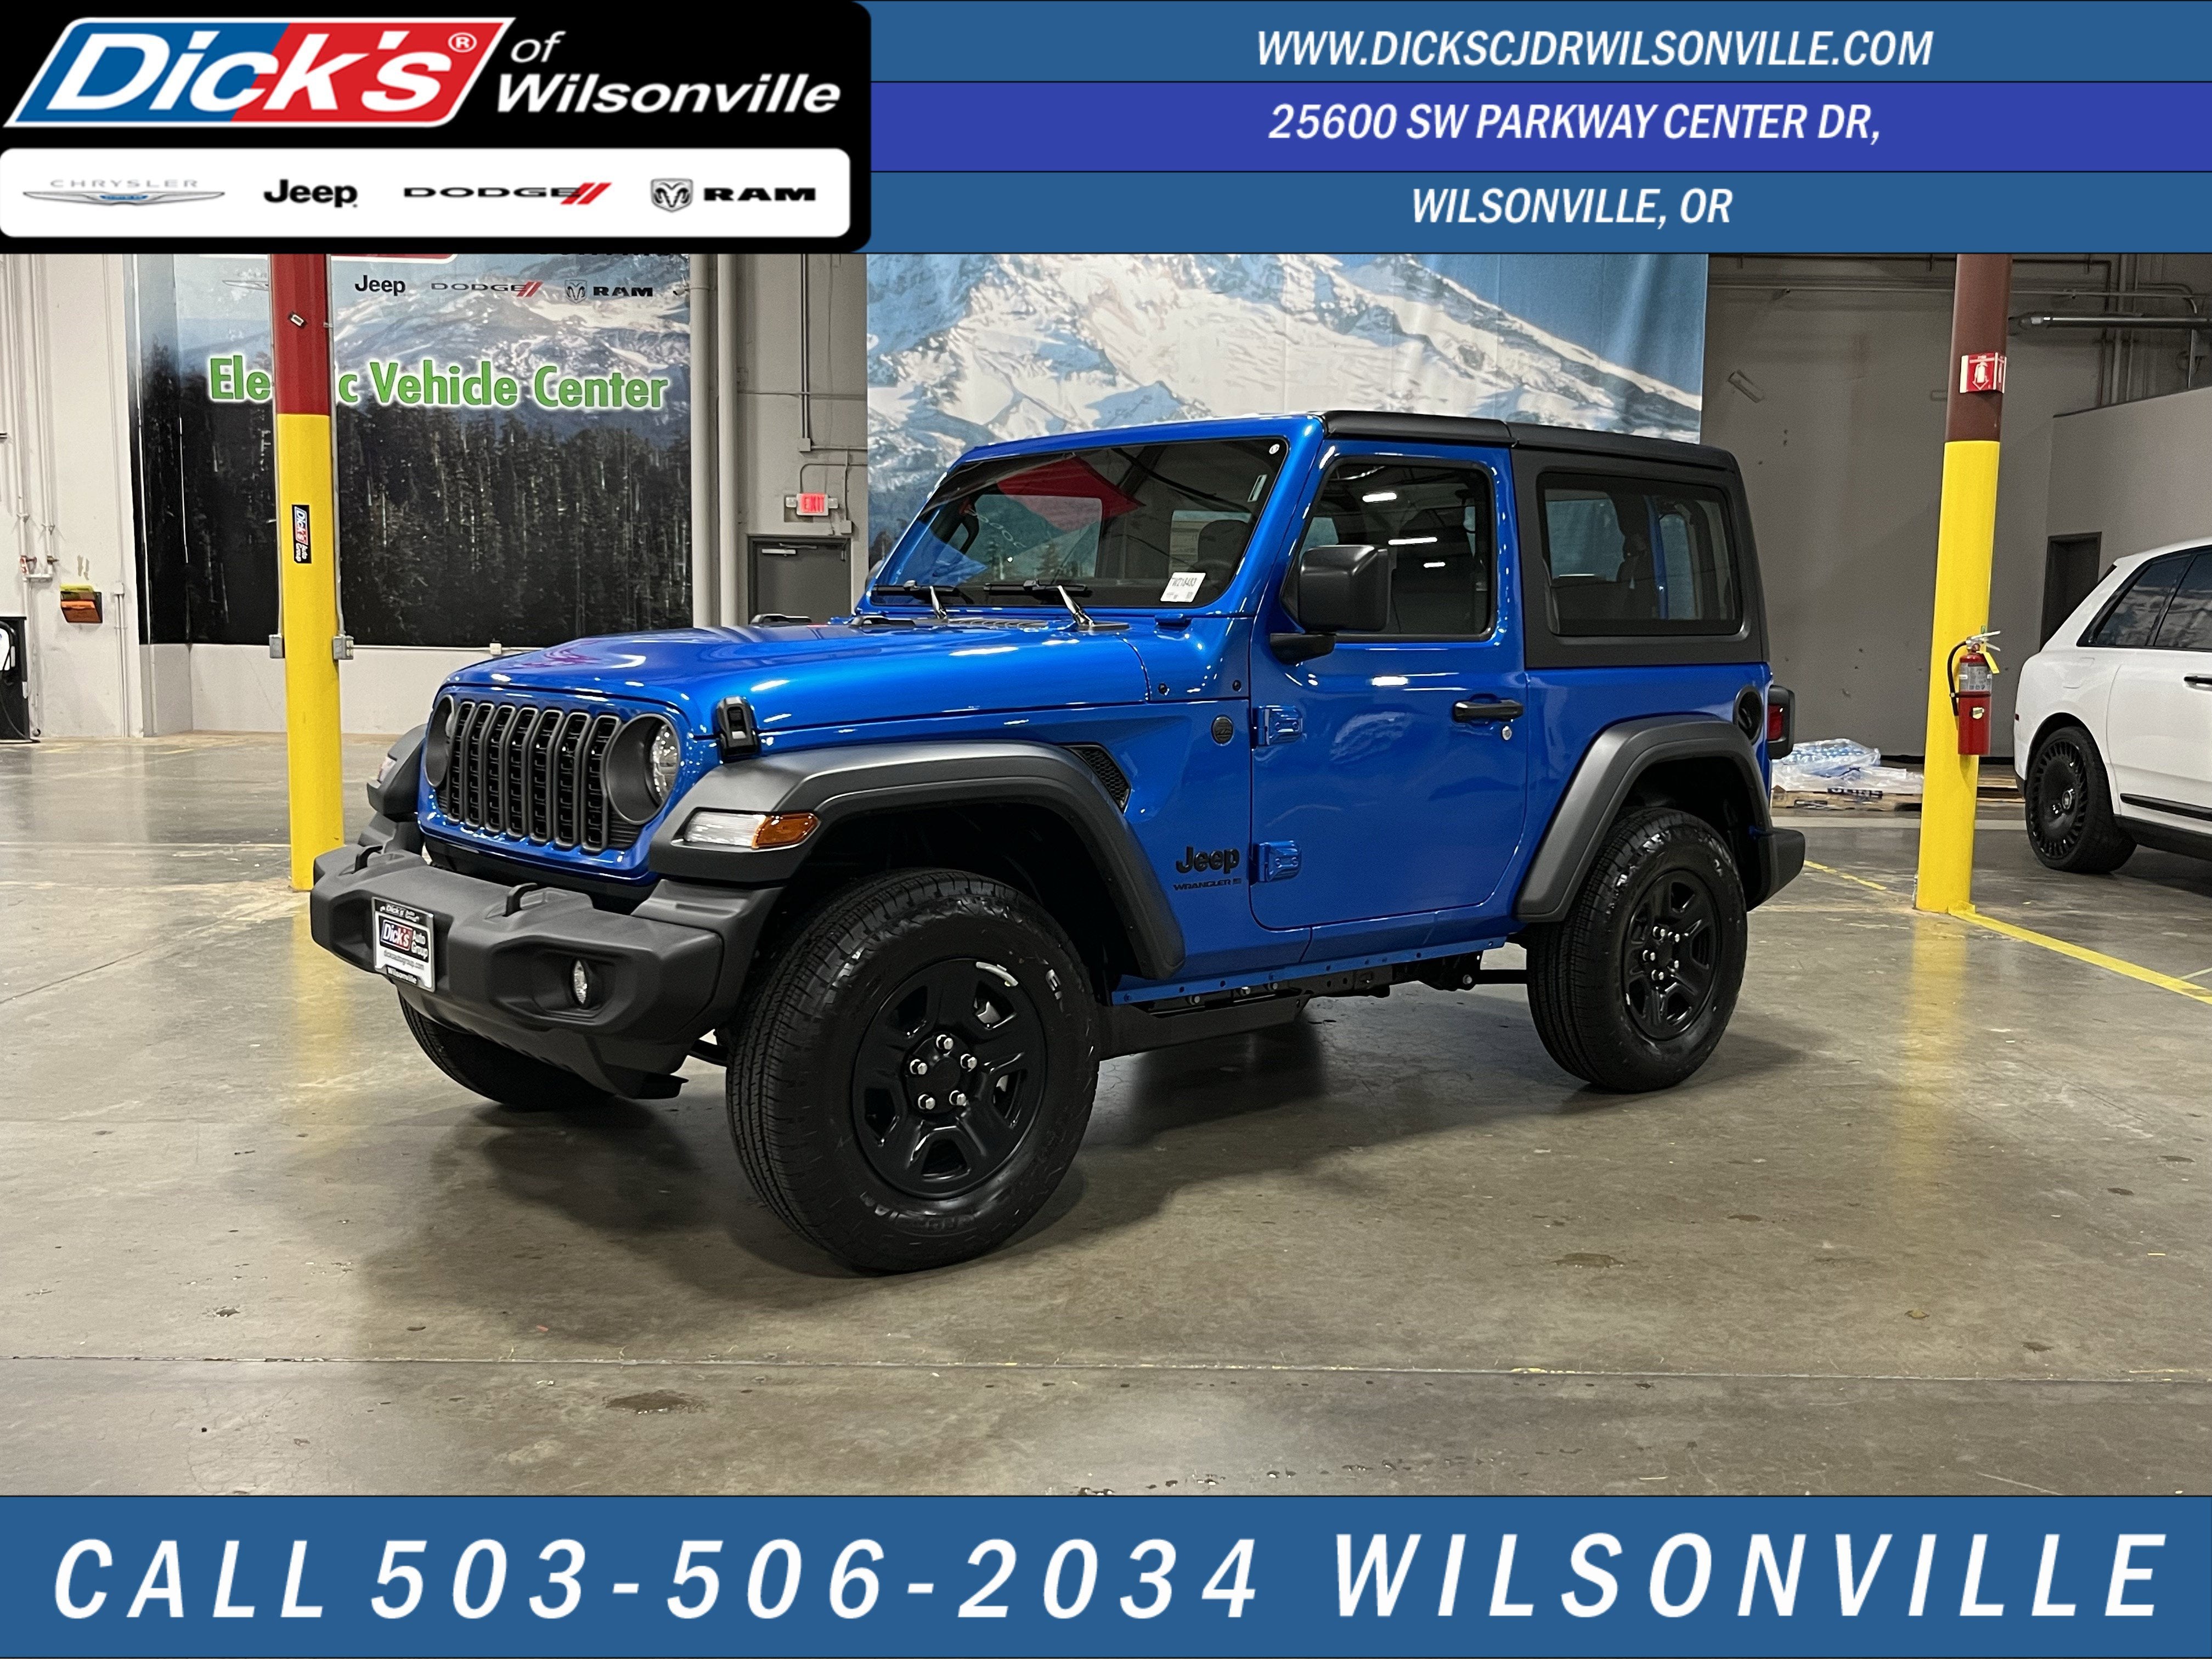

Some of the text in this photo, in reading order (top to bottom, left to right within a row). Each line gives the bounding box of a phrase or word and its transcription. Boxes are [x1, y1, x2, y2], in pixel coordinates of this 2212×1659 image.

[354, 275, 406, 294] Jeep
[431, 283, 527, 291] DODGE
[593, 283, 653, 297] RAM
[371, 360, 516, 404] Vehicle
[535, 365, 669, 408] Center
[804, 495, 825, 512] EXIT
[296, 510, 307, 541] Dick's
[1176, 845, 1240, 874] Jeep
[1173, 879, 1231, 890] WRANGLER
[383, 923, 410, 947] Dick's
[413, 930, 426, 945] Auto
[411, 941, 428, 960] Group
